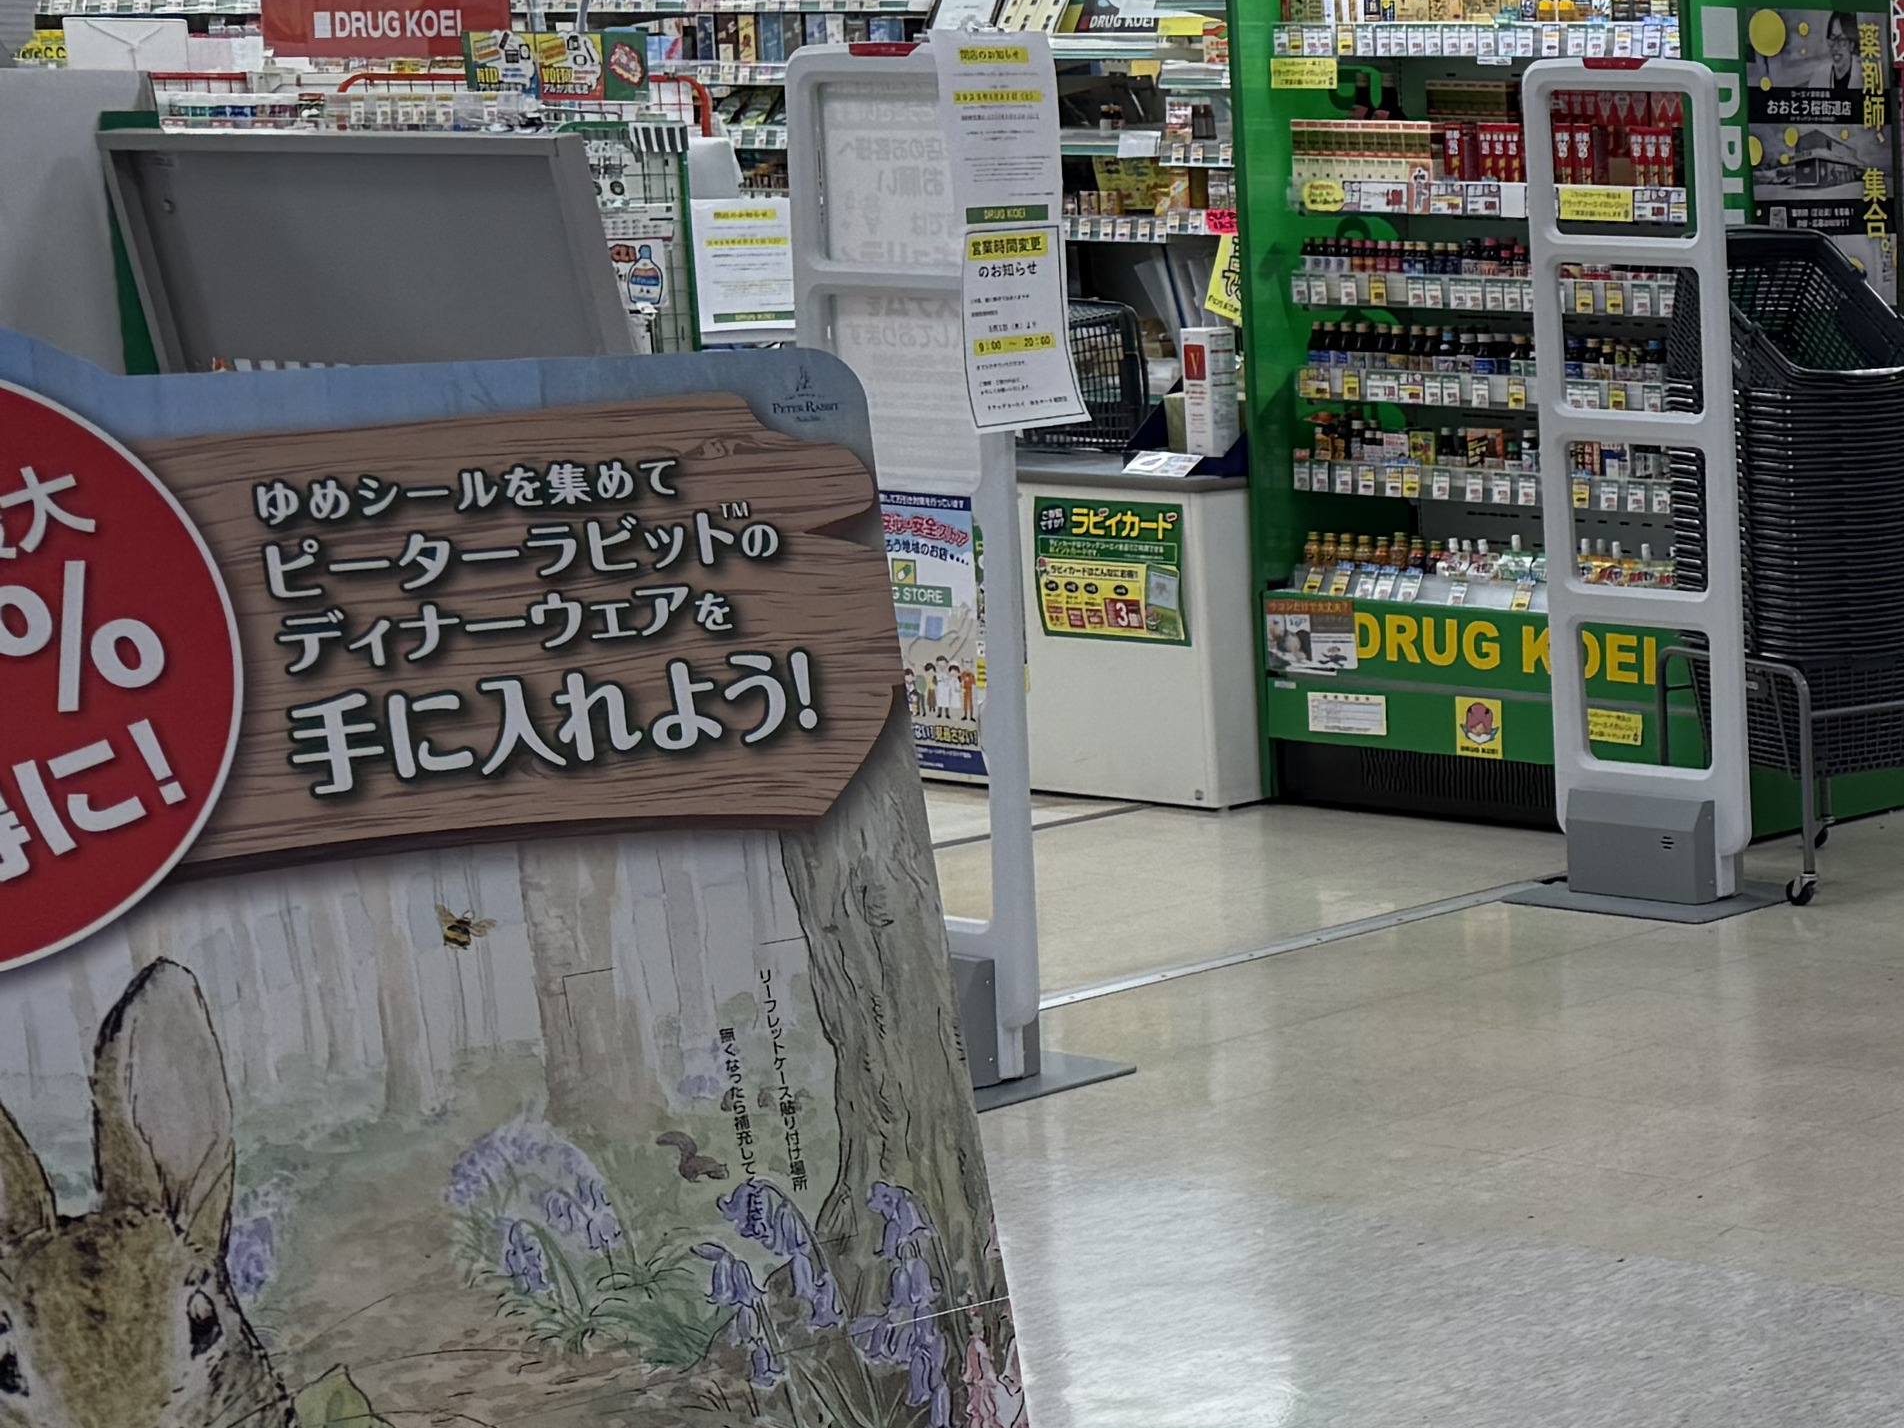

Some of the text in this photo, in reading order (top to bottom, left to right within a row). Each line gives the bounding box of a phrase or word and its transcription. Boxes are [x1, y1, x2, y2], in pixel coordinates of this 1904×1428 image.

[335, 7, 462, 39] DRUG KOEI
[1089, 15, 1122, 29] DRUG
[1766, 99, 1852, 117] おおとう桜街道店
[971, 235, 1043, 256] 営業時間変更
[978, 260, 1038, 279] のお知らせ
[771, 400, 839, 414] PETER RABBIT
[256, 458, 679, 525] ゆめシールを集めて
[902, 588, 944, 604] STORE
[277, 583, 734, 675] ディナーウェアを
[1354, 612, 1501, 671] DRUG
[289, 651, 820, 798] 手に入れよう!
[758, 969, 809, 1192] リーフレットケース貼り付け場所
[719, 1028, 769, 1240] 無くなったら補充してください
